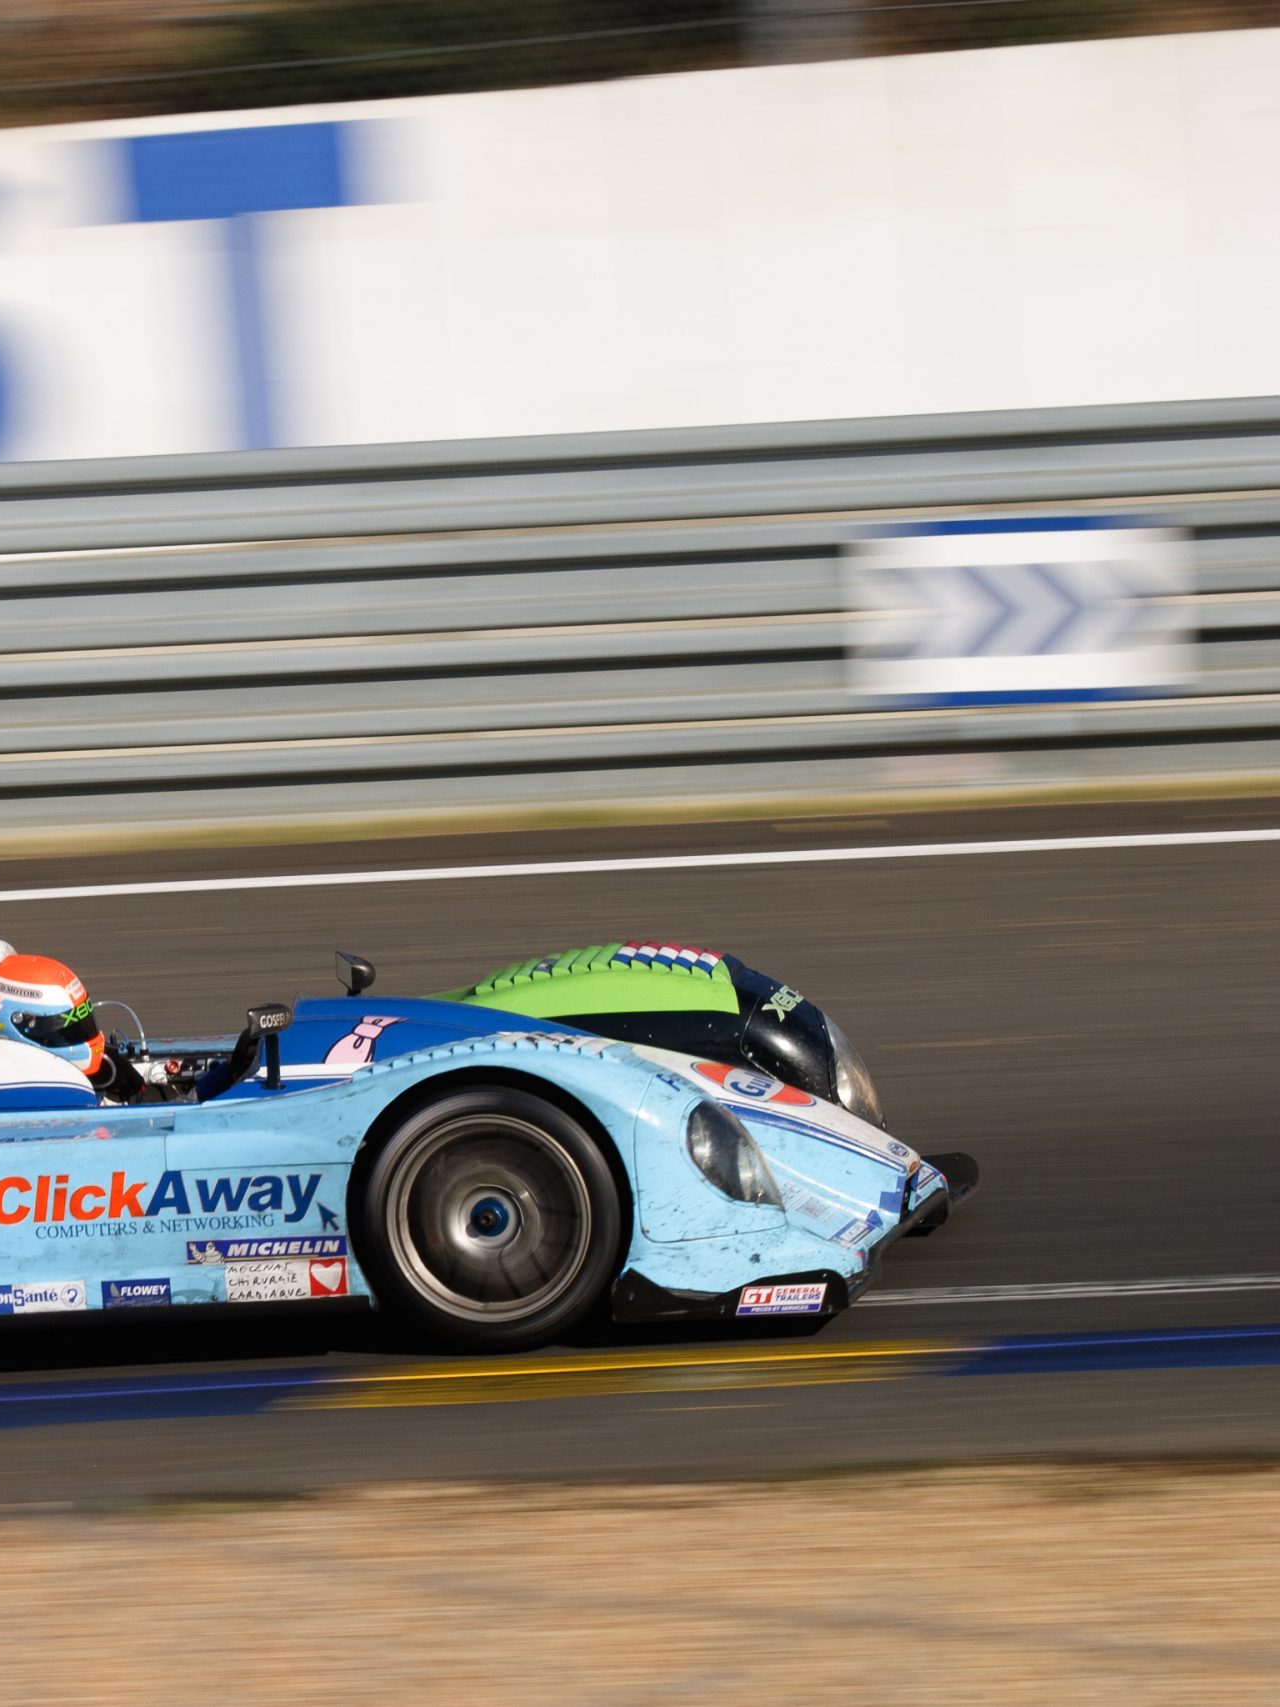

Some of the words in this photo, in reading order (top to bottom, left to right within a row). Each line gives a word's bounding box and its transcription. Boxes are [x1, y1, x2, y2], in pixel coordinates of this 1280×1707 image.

[35, 1220, 138, 1240] COMPUTERS
[143, 1219, 155, 1234] &
[160, 1213, 275, 1233] NETWORKING
[226, 1239, 340, 1257] MICHELIN
[120, 1284, 167, 1297] FLOWEY
[742, 1287, 773, 1304] GT
[775, 1286, 820, 1294] GENERAL
[775, 1293, 820, 1302] TRAILERS
